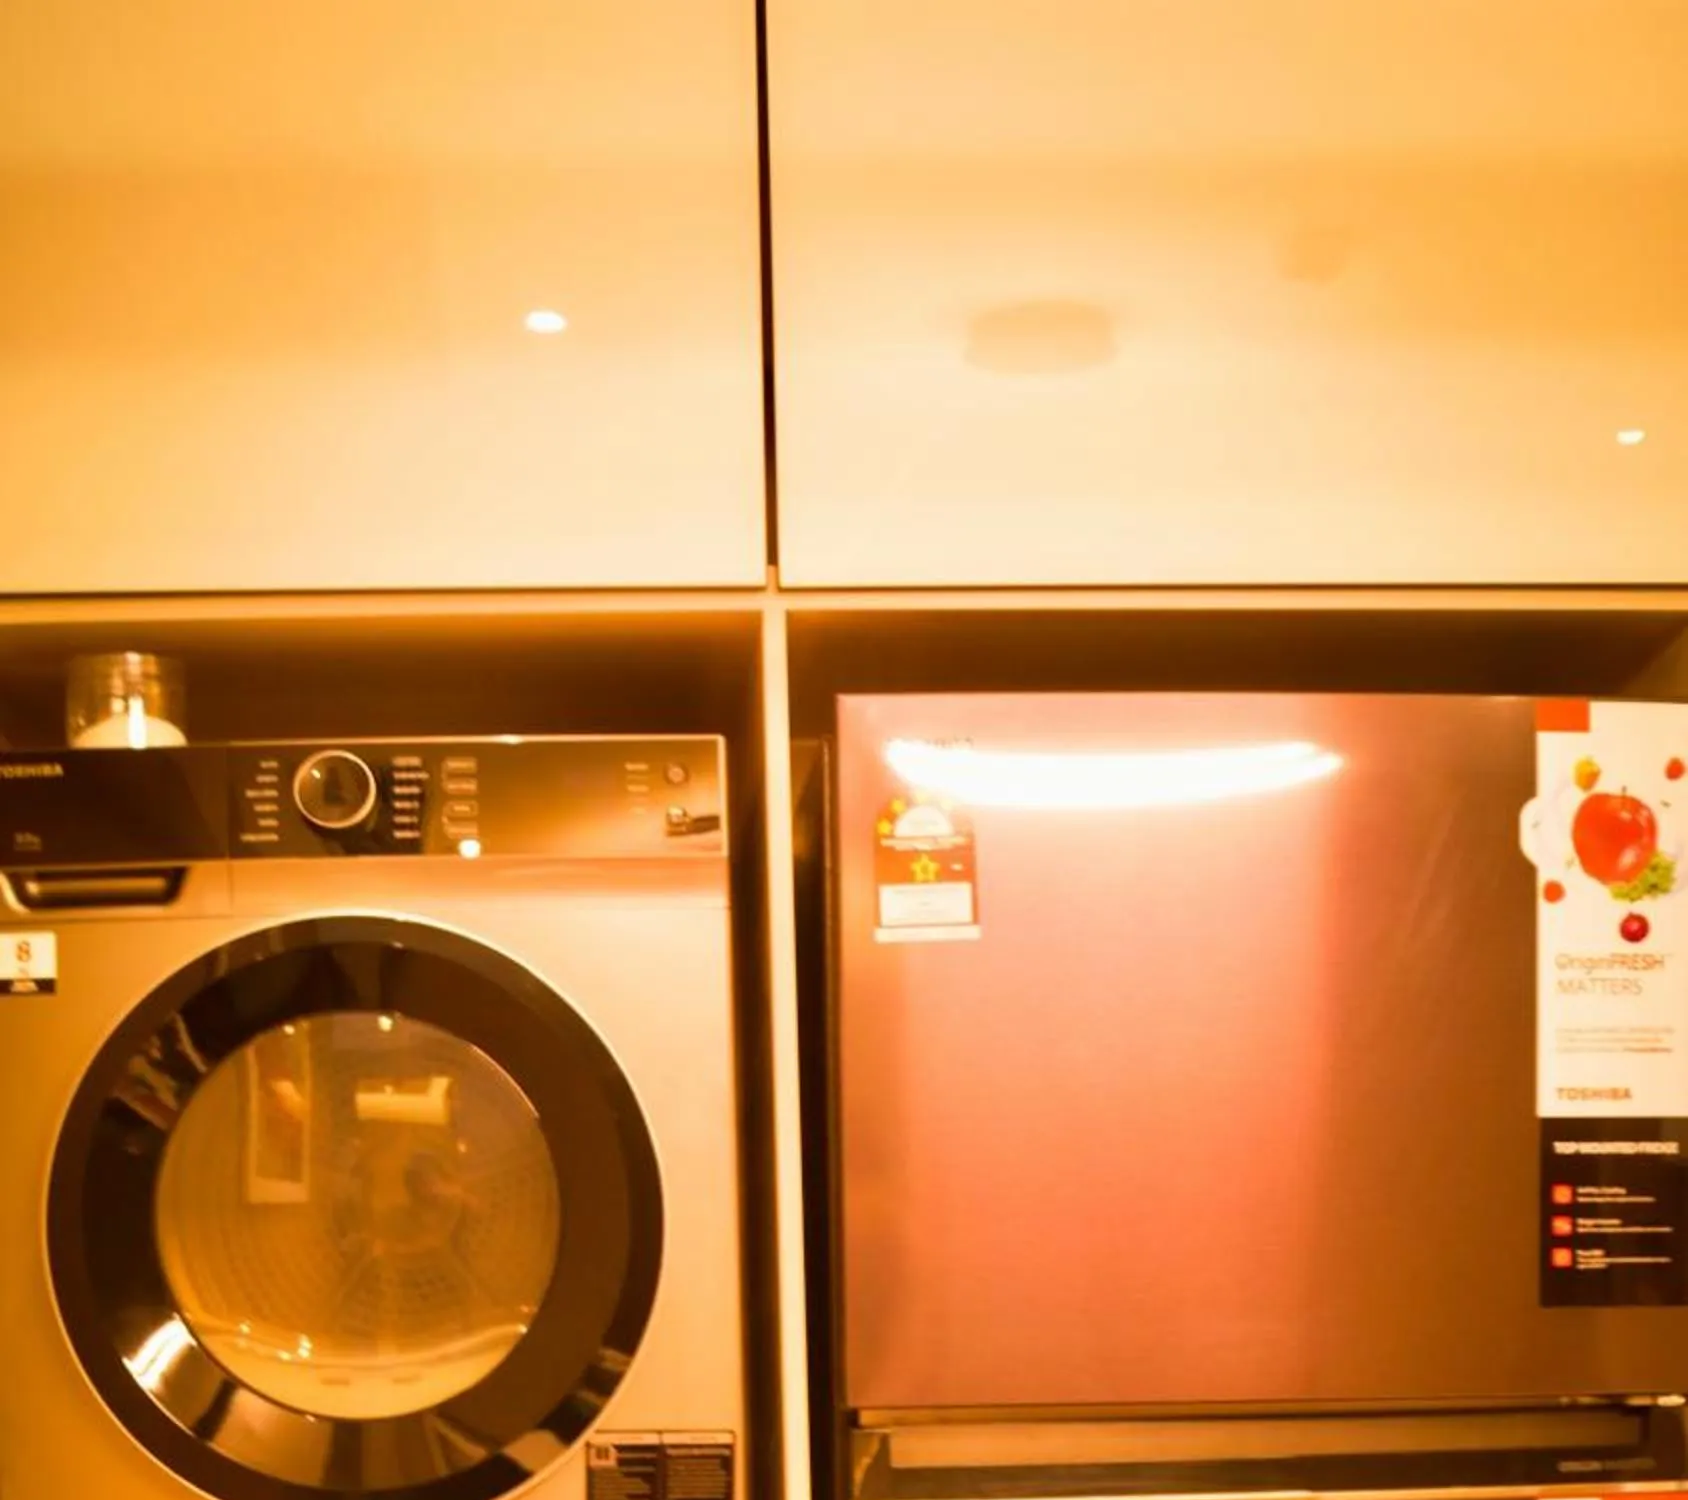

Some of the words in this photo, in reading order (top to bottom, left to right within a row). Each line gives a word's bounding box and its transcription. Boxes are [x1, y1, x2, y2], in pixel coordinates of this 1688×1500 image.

[17, 940, 32, 963] 8
[1554, 953, 1665, 975] OriginFRESH
[1557, 978, 1644, 996] MATTERS
[1556, 1087, 1633, 1101] TOSHIBA
